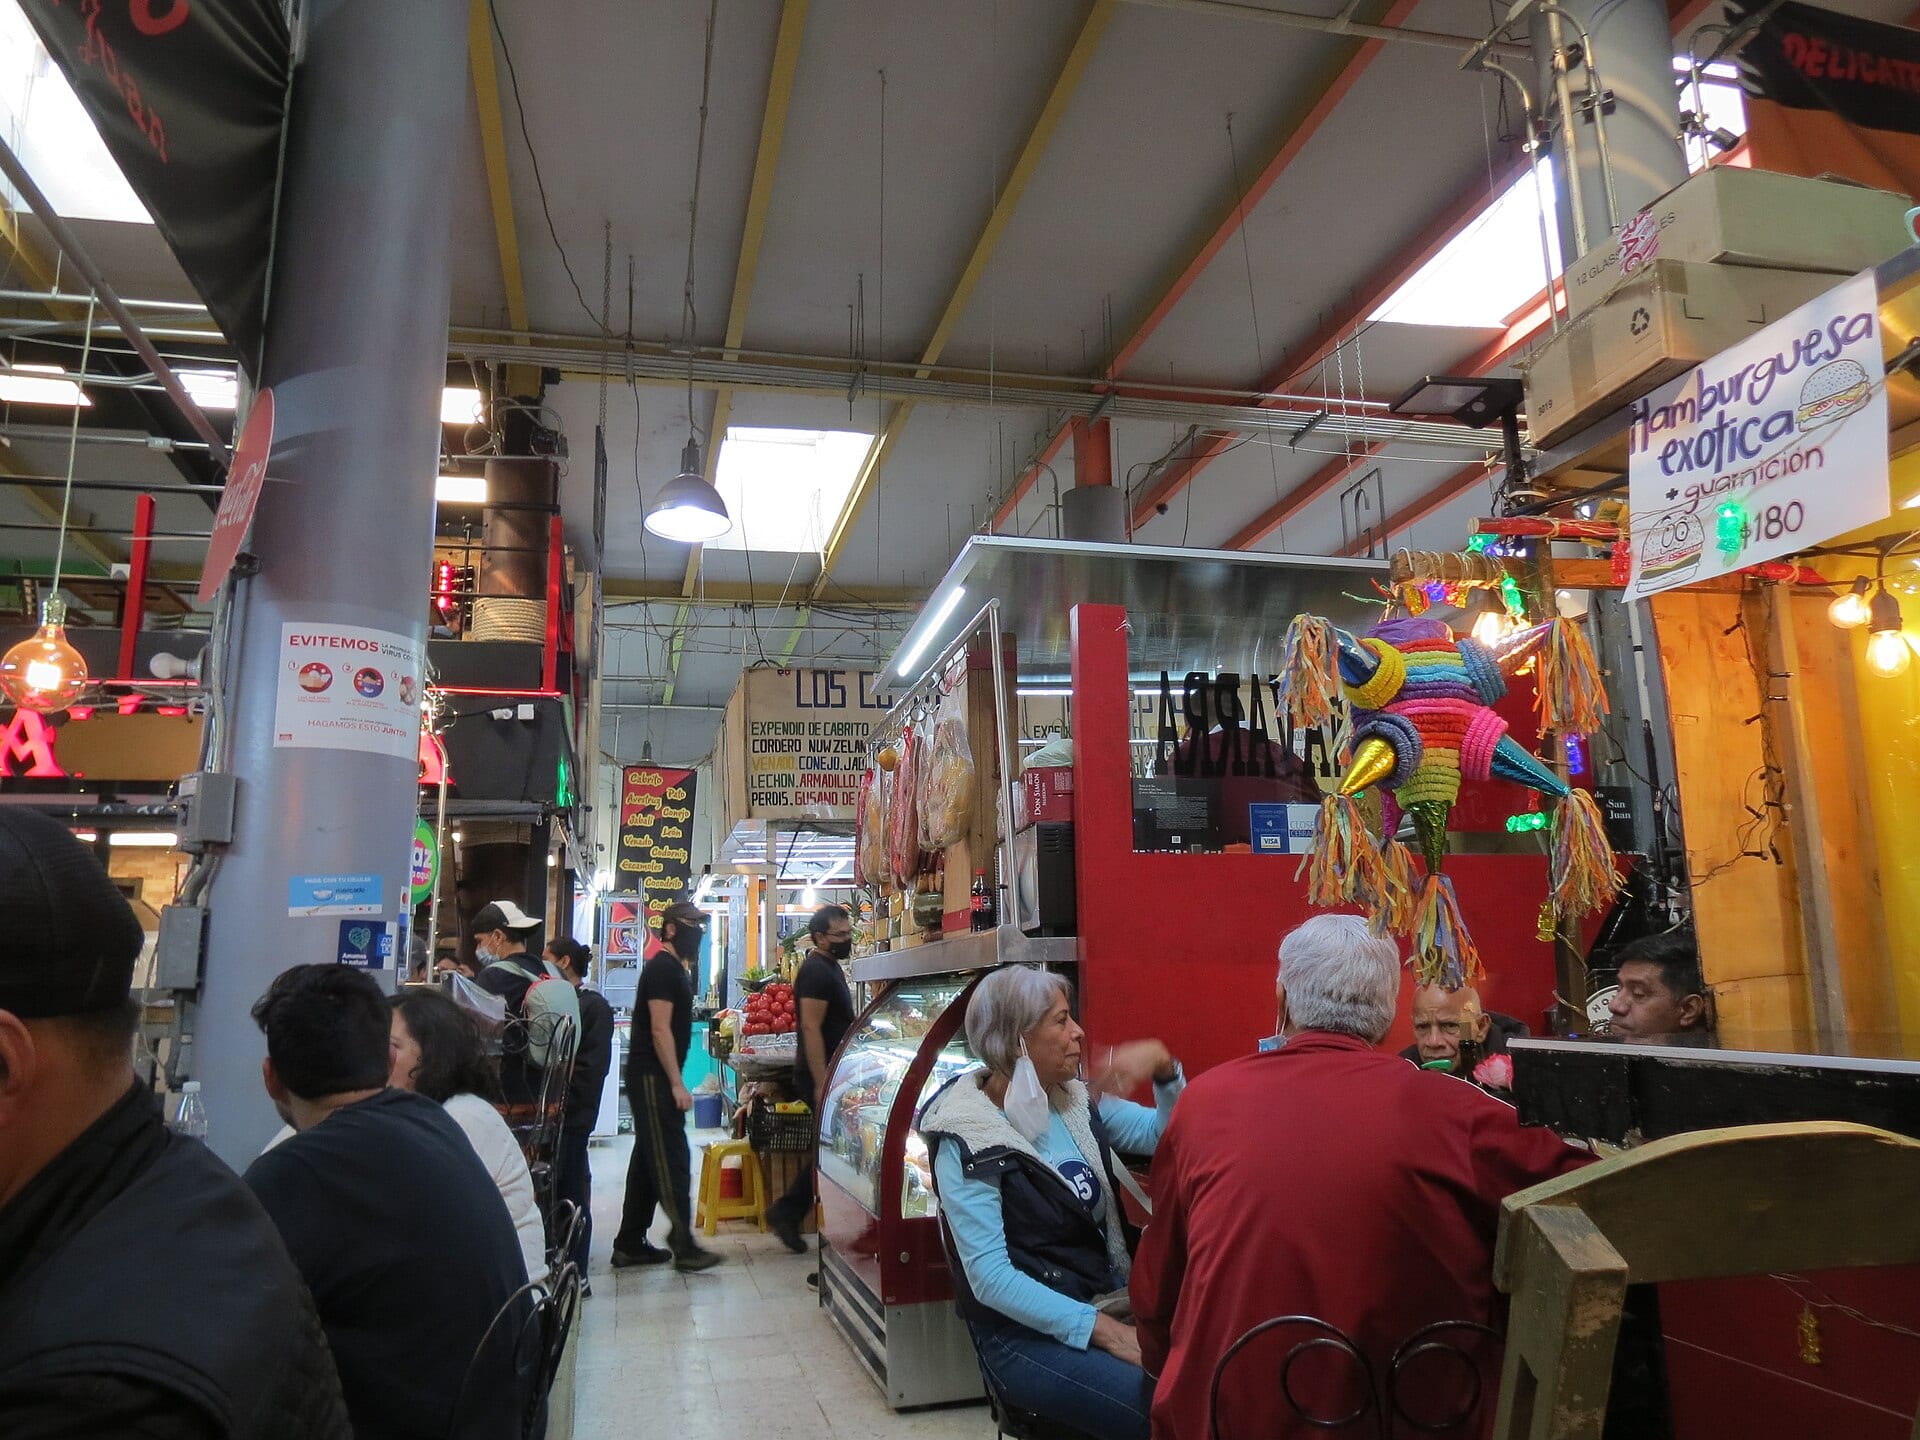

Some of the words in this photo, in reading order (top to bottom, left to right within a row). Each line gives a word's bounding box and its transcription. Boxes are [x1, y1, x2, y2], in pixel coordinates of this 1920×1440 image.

[1576, 272, 1588, 287] 12
[1630, 312, 1873, 455] Hamburguesa
[1657, 409, 1794, 476] exotica
[1740, 501, 1804, 549] $180
[289, 634, 379, 653] EVITEMOS
[381, 648, 401, 658] VIRUS
[796, 670, 846, 708] LOS
[308, 720, 357, 730] HAGAMOS
[359, 721, 380, 733] ESTO
[751, 722, 805, 736] EXPENDIO
[808, 722, 821, 736] DE
[823, 722, 869, 736] CABRITO
[752, 739, 802, 753] CORDERO
[629, 772, 663, 786] Cabrito
[666, 787, 687, 801] Pato
[795, 791, 838, 806] GUSANO
[842, 791, 855, 805] DE
[626, 793, 662, 810] Avestruz
[1607, 799, 1626, 808] San
[662, 807, 691, 822] Conejo
[1609, 810, 1632, 819] Juan
[624, 835, 653, 847] Venado
[650, 846, 688, 864] Codorniz
[620, 859, 664, 871] Escamoles
[644, 876, 684, 889] Cocodrilo
